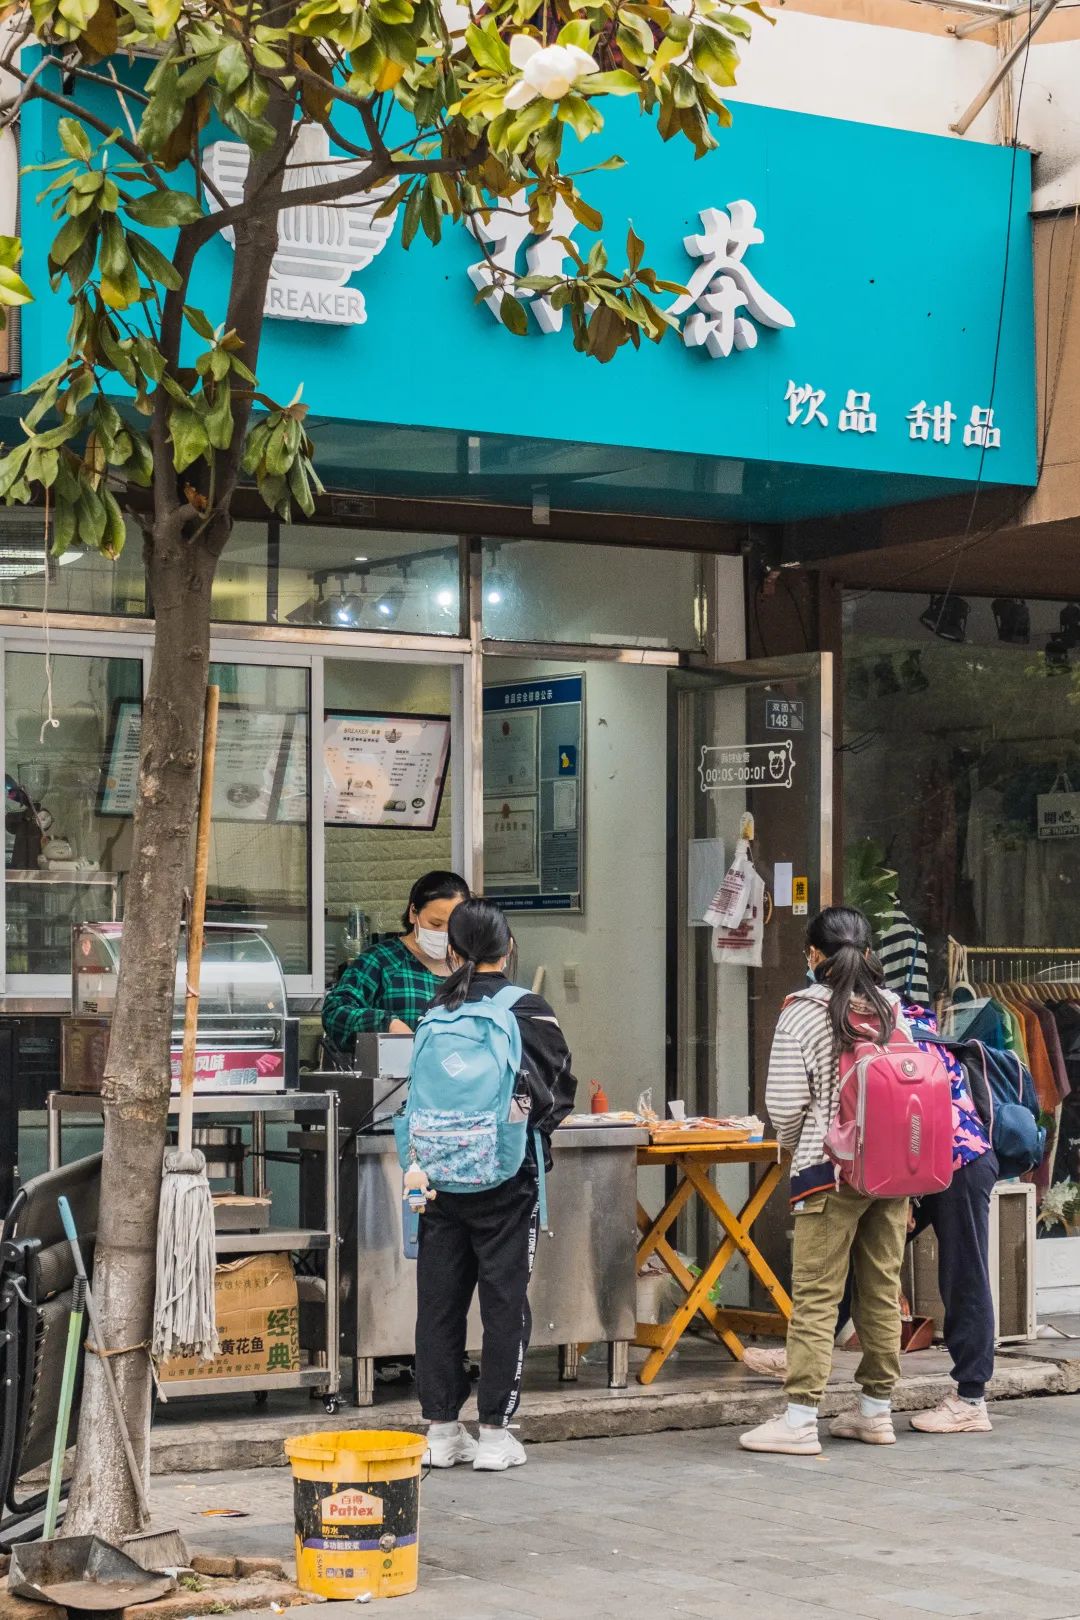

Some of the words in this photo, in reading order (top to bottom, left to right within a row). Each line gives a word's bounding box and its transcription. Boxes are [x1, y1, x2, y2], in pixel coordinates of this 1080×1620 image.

[266, 287, 362, 319] REAKER
[783, 380, 877, 434] 饮品
[905, 400, 1001, 449] 甜品
[771, 714, 788, 727] 148
[195, 1054, 225, 1073] 风味
[528, 1227, 537, 1254] STONE
[266, 1308, 291, 1371] 经典
[505, 1390, 518, 1415] STONE
[329, 1504, 373, 1516] Pattex
